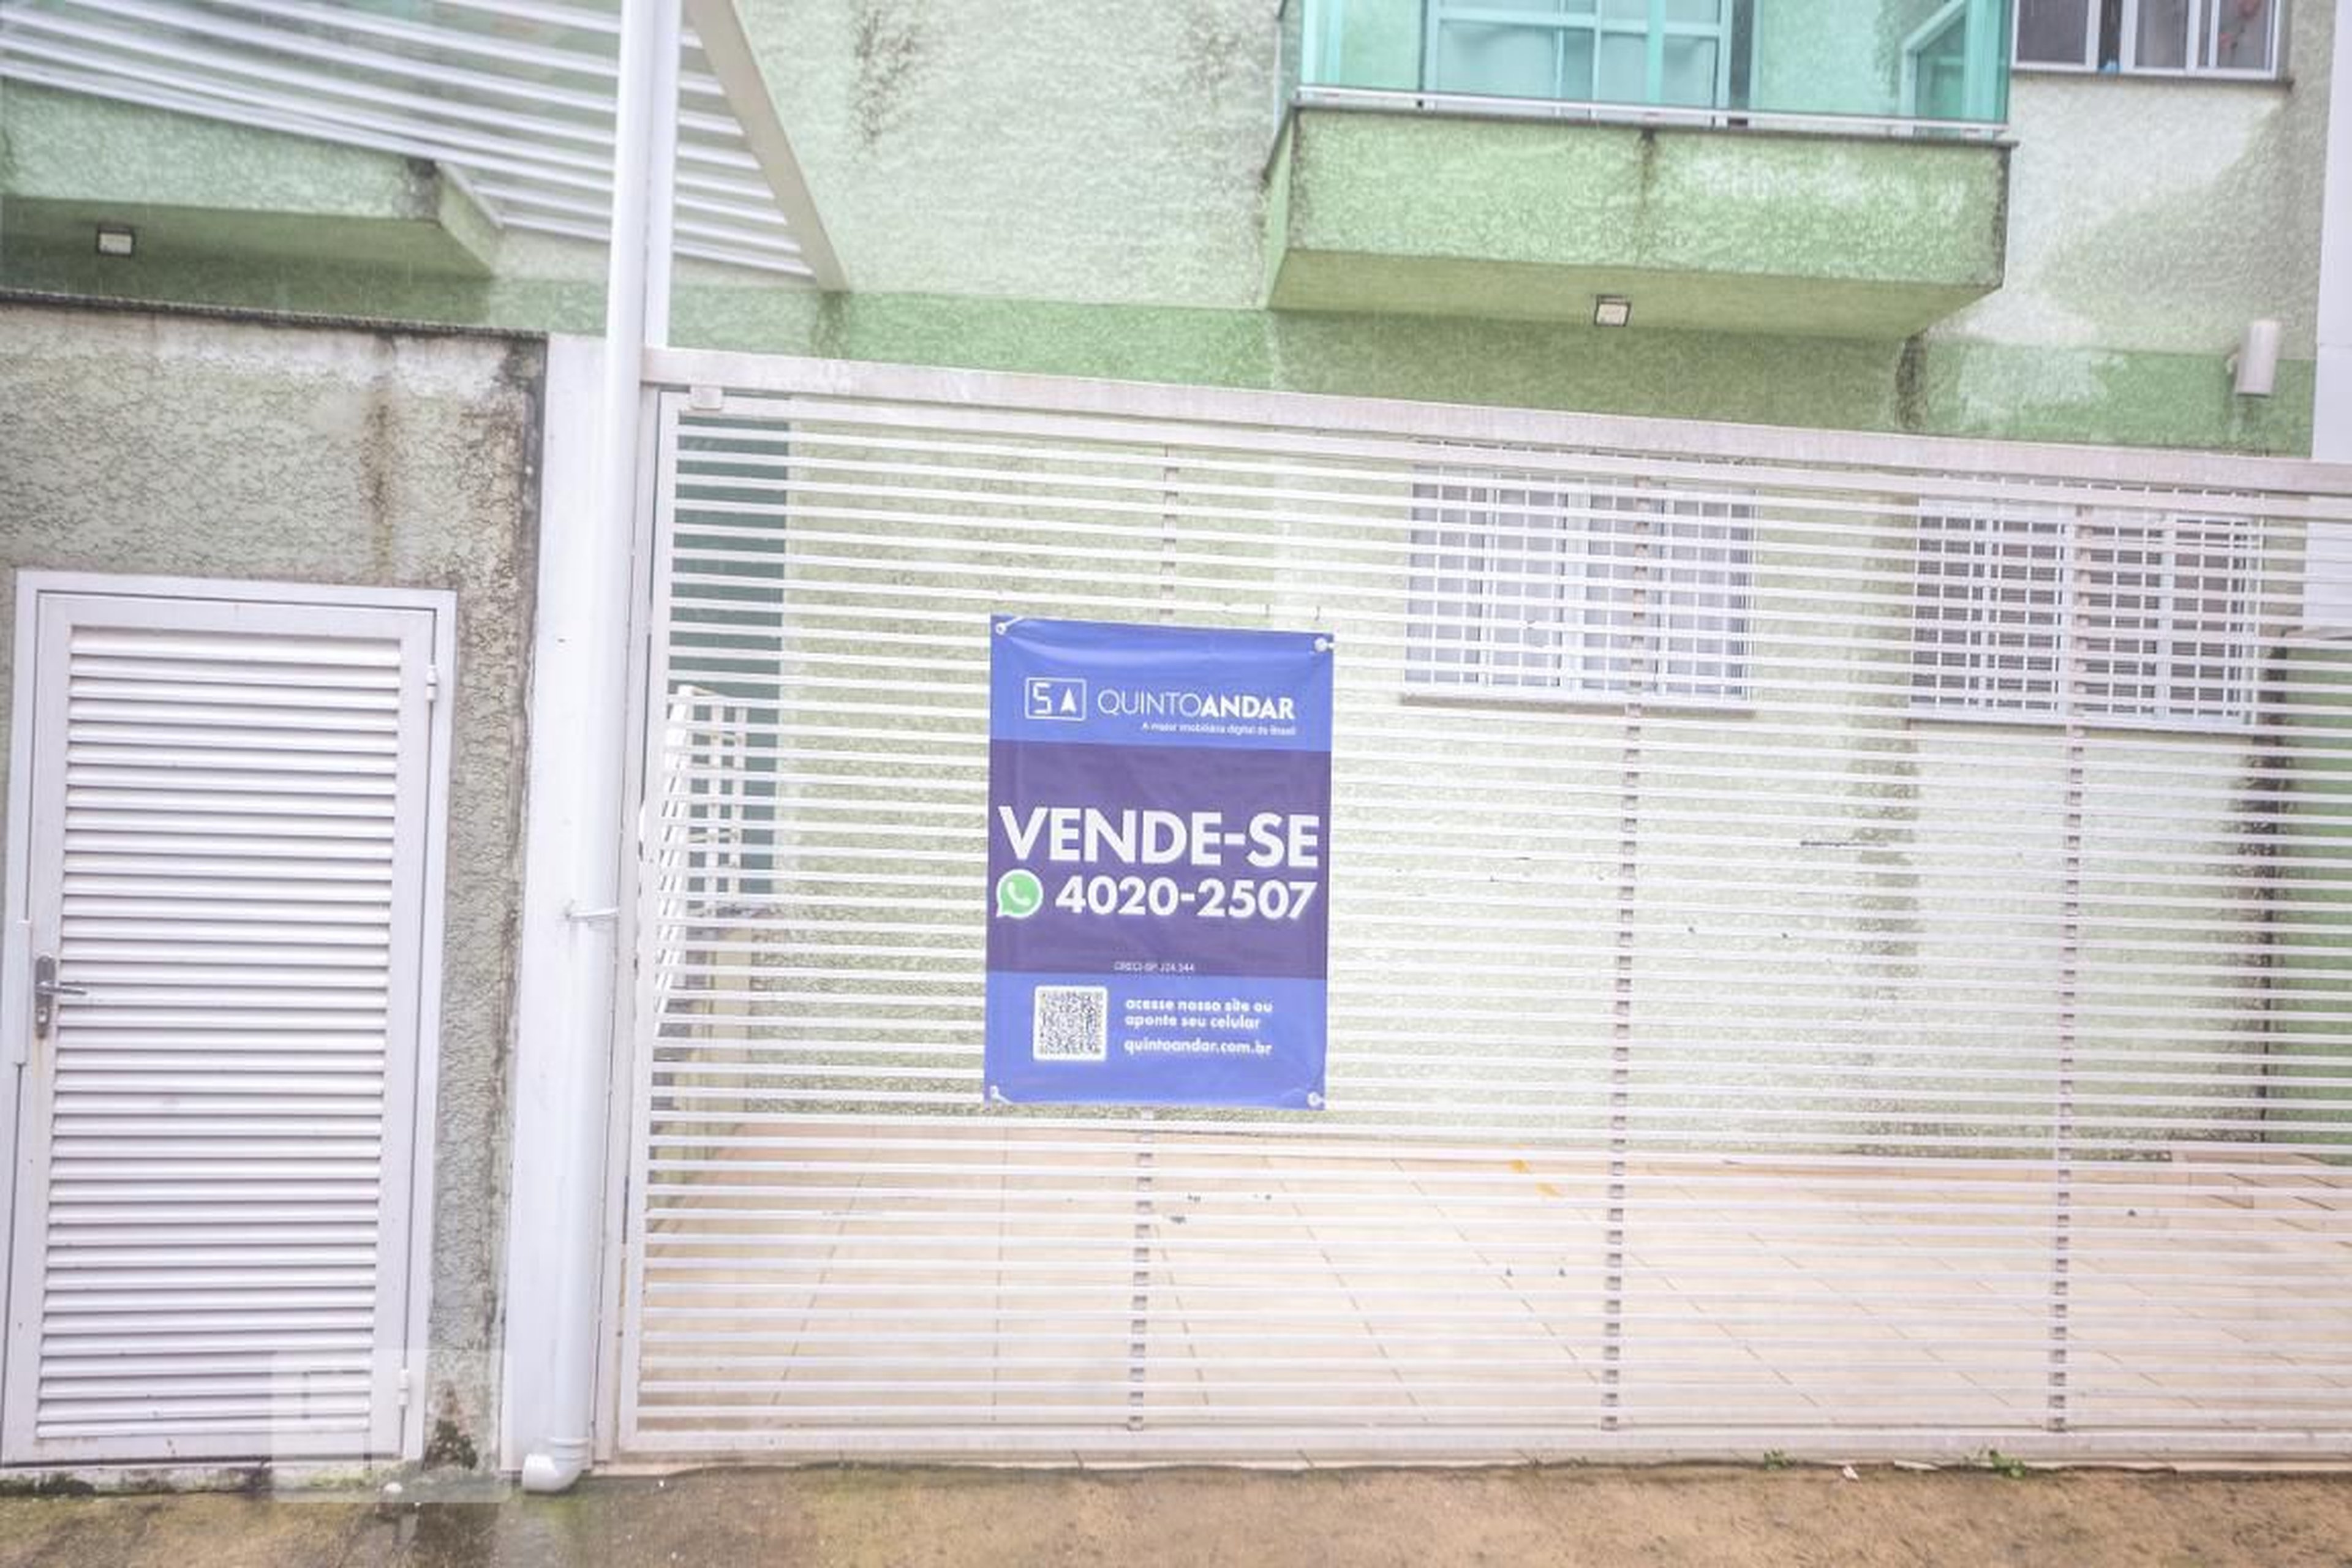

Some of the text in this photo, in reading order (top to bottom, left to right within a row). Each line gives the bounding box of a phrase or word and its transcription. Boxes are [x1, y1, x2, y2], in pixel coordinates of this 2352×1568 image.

[1097, 688, 1296, 720] QUINTOANDAR
[998, 805, 1320, 869] VENDE-SE
[1055, 875, 1317, 919] 4020-2507
[1126, 997, 1273, 1014] acesse nosso site ou
[1125, 1014, 1261, 1030] aponte seu celular
[1124, 1037, 1273, 1055] quintoandar.com.br
